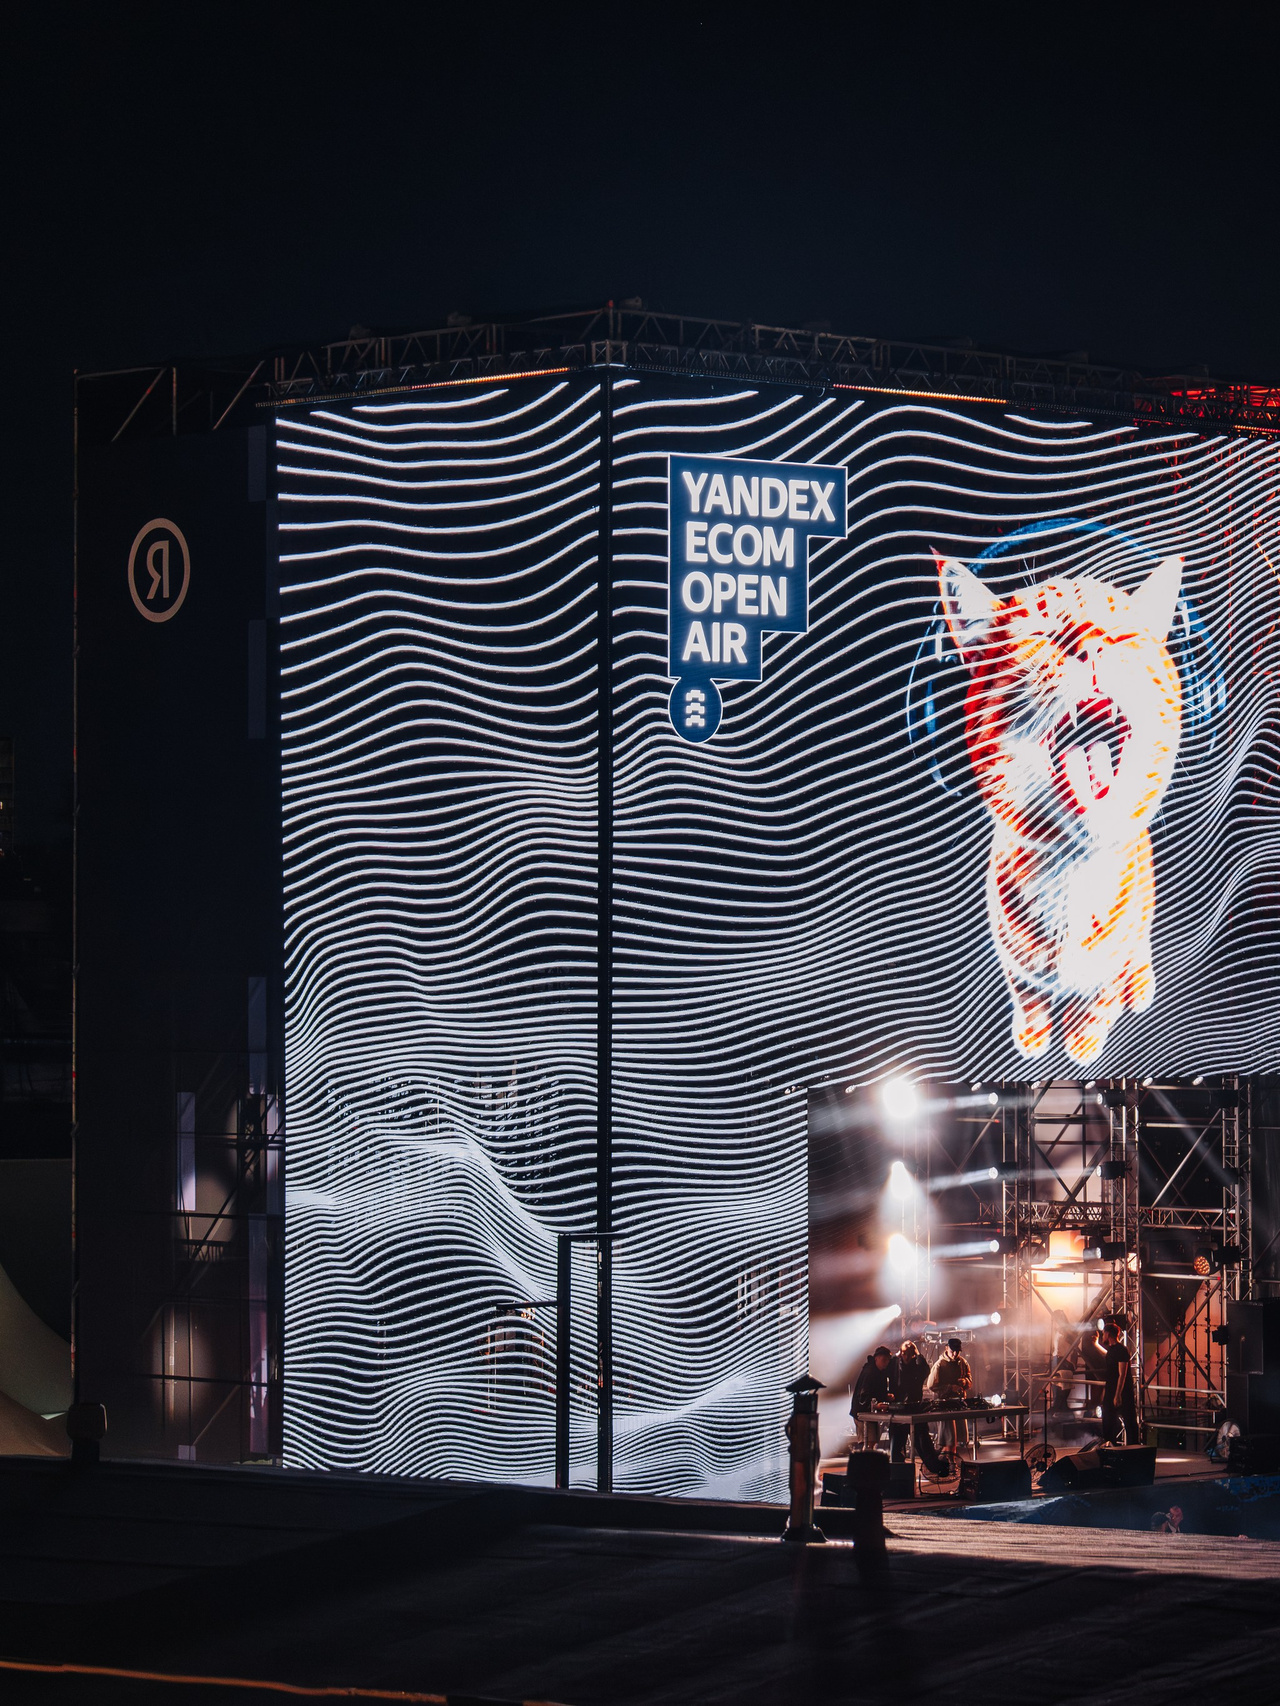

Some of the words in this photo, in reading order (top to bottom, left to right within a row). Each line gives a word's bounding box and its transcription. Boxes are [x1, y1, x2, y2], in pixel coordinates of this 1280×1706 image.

[683, 471, 835, 521] YANDEX
[686, 521, 794, 567] ECOM
[682, 571, 787, 616] OPEN
[682, 621, 747, 663] AIR
